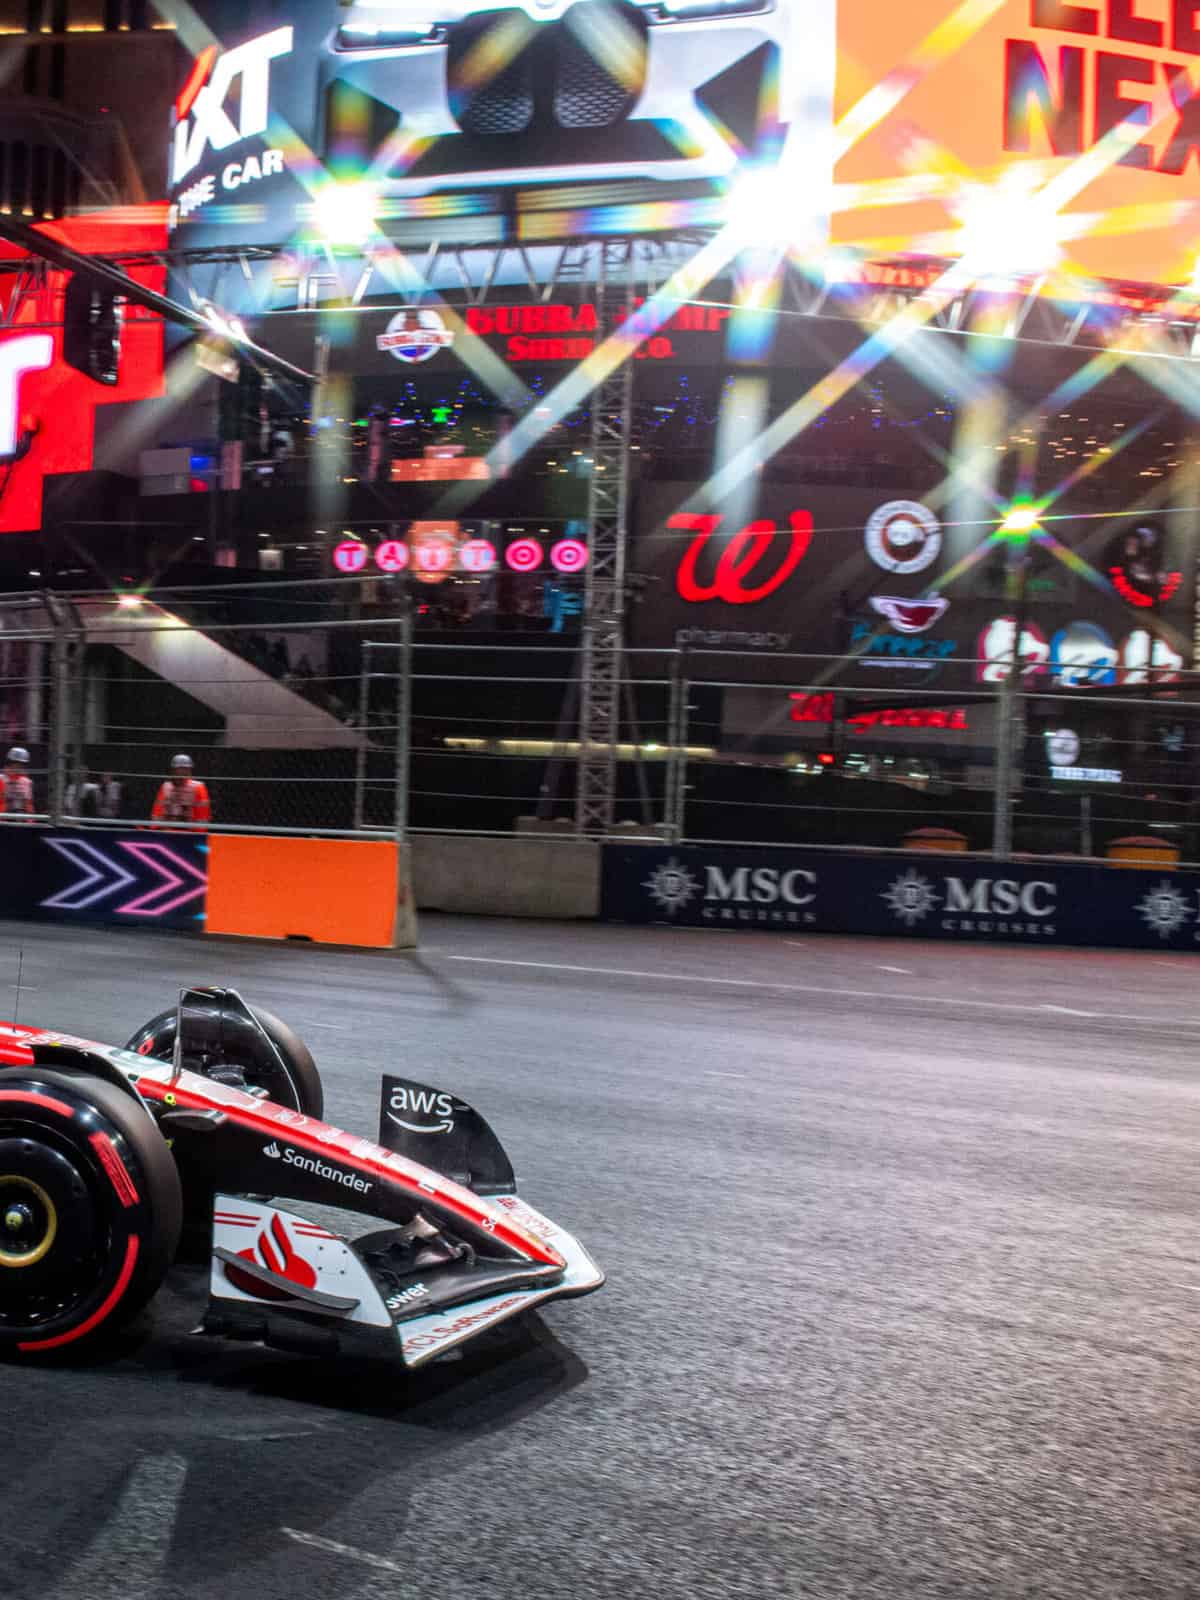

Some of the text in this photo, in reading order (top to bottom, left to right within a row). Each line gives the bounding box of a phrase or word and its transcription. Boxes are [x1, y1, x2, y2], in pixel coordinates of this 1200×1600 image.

[221, 149, 285, 190] CAR
[334, 539, 589, 573] TATTOO
[675, 628, 792, 650] pharmacy
[703, 866, 818, 904] MSC
[942, 877, 1058, 916] MSC
[702, 906, 817, 924] CRUISES
[941, 918, 1057, 936] CRUISES
[389, 1086, 454, 1118] aws
[282, 1148, 373, 1195] Santander
